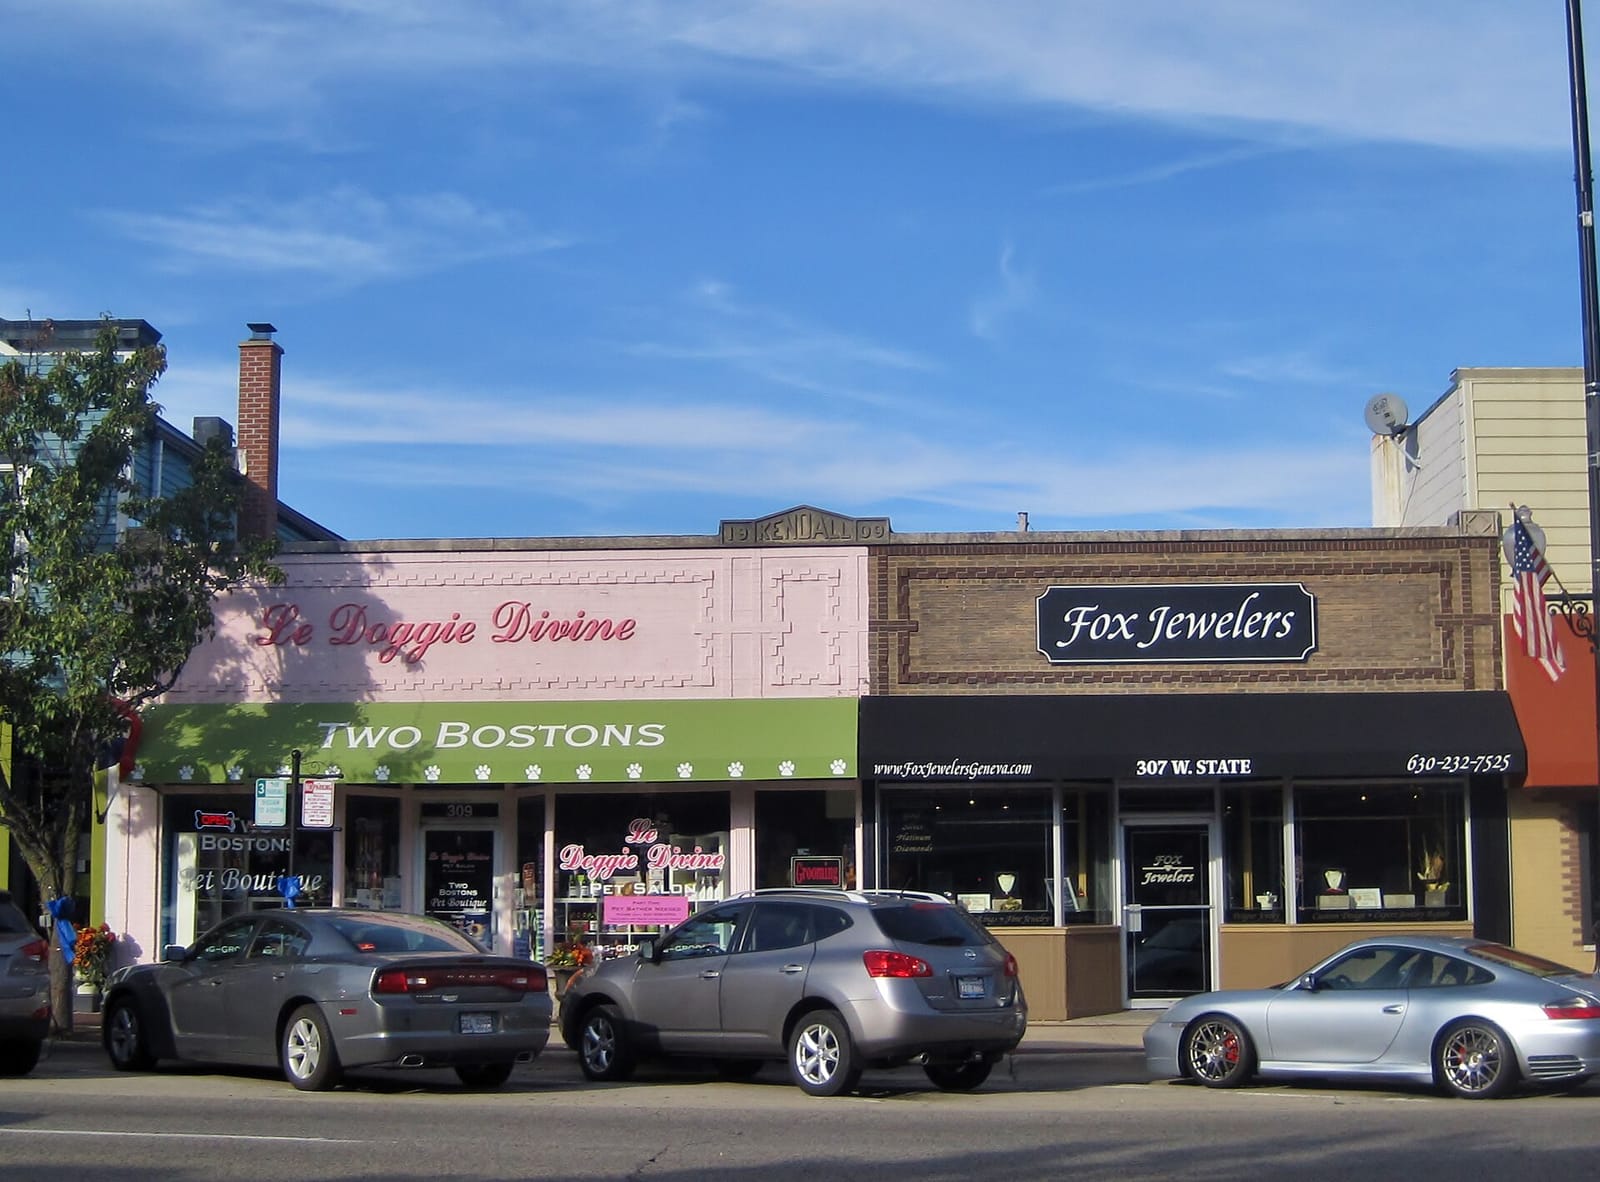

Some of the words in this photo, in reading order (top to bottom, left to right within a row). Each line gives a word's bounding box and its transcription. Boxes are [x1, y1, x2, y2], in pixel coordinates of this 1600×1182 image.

[727, 525, 749, 542] 19
[758, 513, 852, 542] KENDALL
[861, 525, 885, 540] 09
[1055, 604, 1139, 649] Fox
[1136, 591, 1296, 649] Jewelers
[255, 603, 314, 646] Le
[328, 603, 477, 664] Doggie
[491, 600, 637, 643] Divine
[435, 720, 667, 750] BOSTONS
[873, 758, 1033, 780] www.FoxJewelersGeneva.com
[1136, 759, 1169, 776] 307
[1170, 759, 1193, 775] W.
[1196, 759, 1252, 775] STATE
[1406, 754, 1512, 774] 630-232-7525
[200, 815, 230, 826] OPEN
[447, 804, 473, 817] 309
[625, 818, 658, 844] Le
[559, 844, 639, 880] Doggie
[647, 844, 726, 870] Divine
[1140, 868, 1195, 885] Jewelers
[633, 882, 697, 896] SALON
